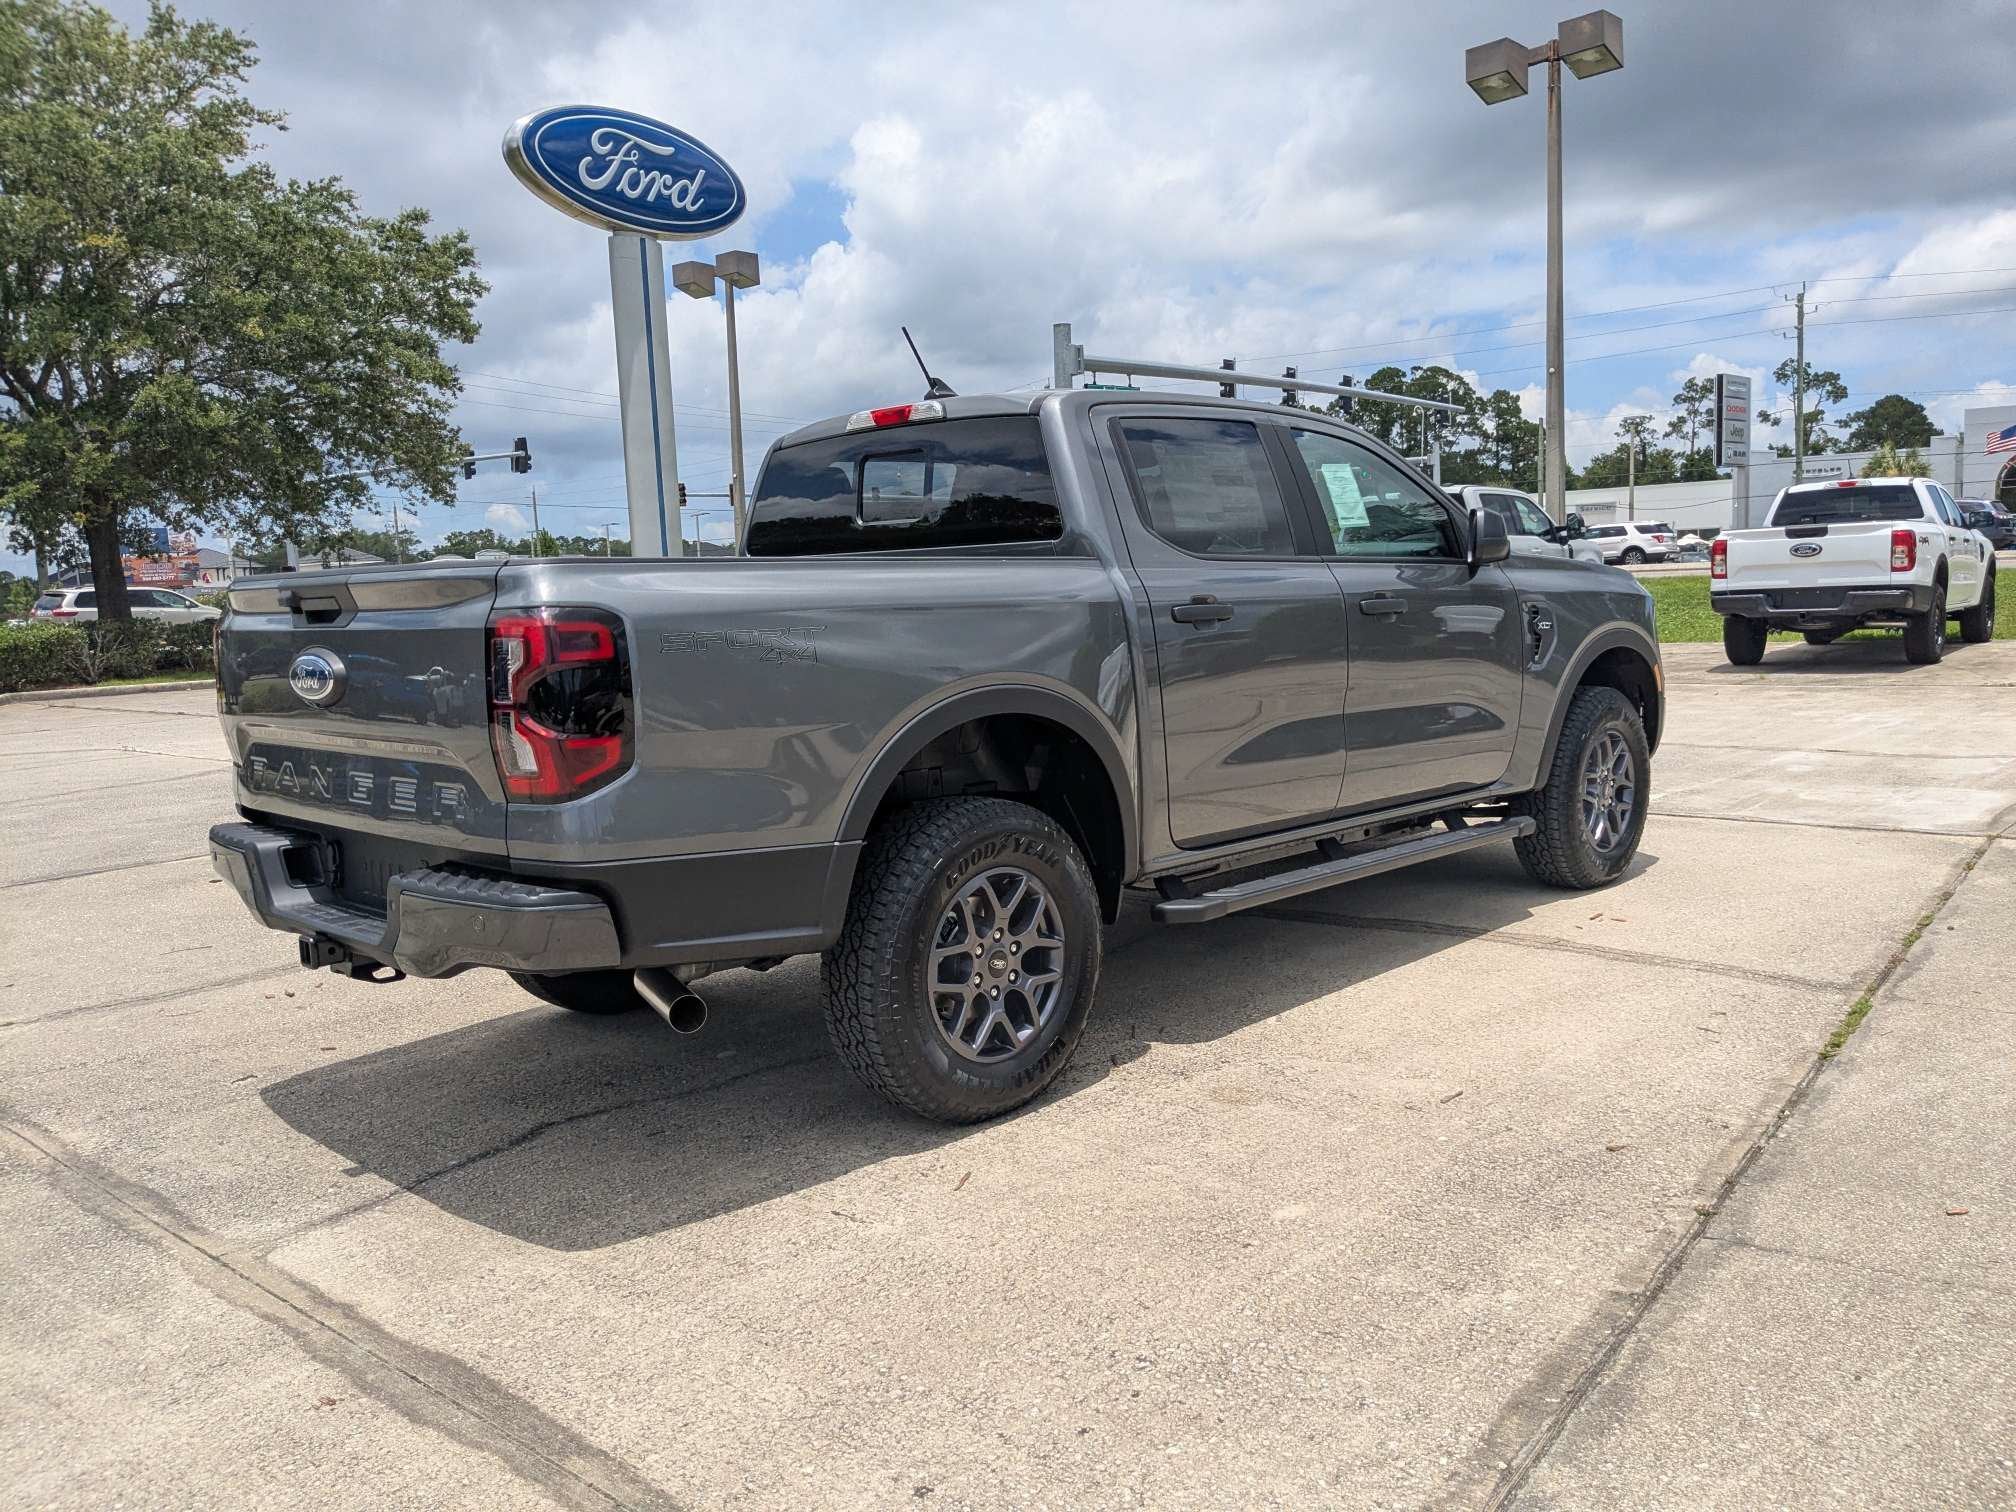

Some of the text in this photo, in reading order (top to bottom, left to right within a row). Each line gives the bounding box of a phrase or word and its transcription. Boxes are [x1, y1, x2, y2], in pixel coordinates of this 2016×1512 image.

[578, 127, 705, 212] Ford
[1730, 424, 1745, 439] Jeep
[1733, 449, 1746, 458] RAM
[1537, 621, 1552, 630] XLT
[660, 625, 828, 653] SPORT
[295, 664, 320, 689] Ford
[249, 755, 469, 819] RANGER
[944, 832, 1060, 890] GOODYEAR
